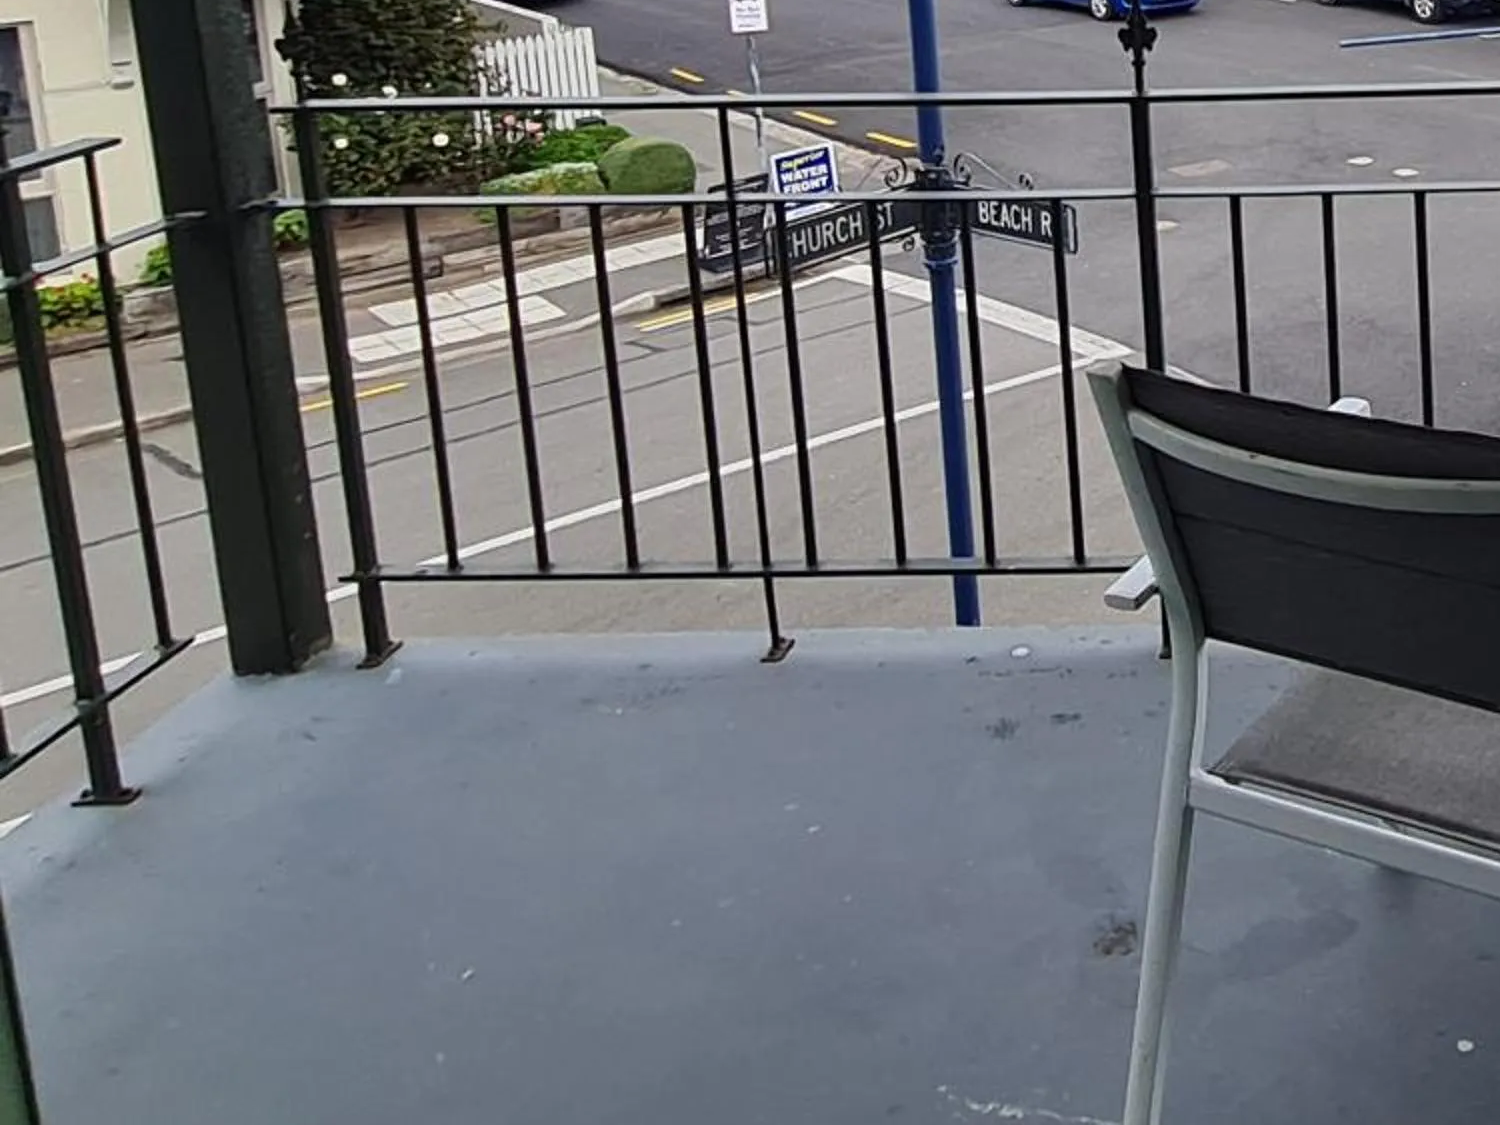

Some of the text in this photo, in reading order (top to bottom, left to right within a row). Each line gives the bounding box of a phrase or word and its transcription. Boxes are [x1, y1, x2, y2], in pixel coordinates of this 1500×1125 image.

[780, 164, 829, 184] WATER
[783, 176, 829, 194] FRONT
[978, 200, 1033, 234] BEACH
[787, 210, 864, 259] HURCH
